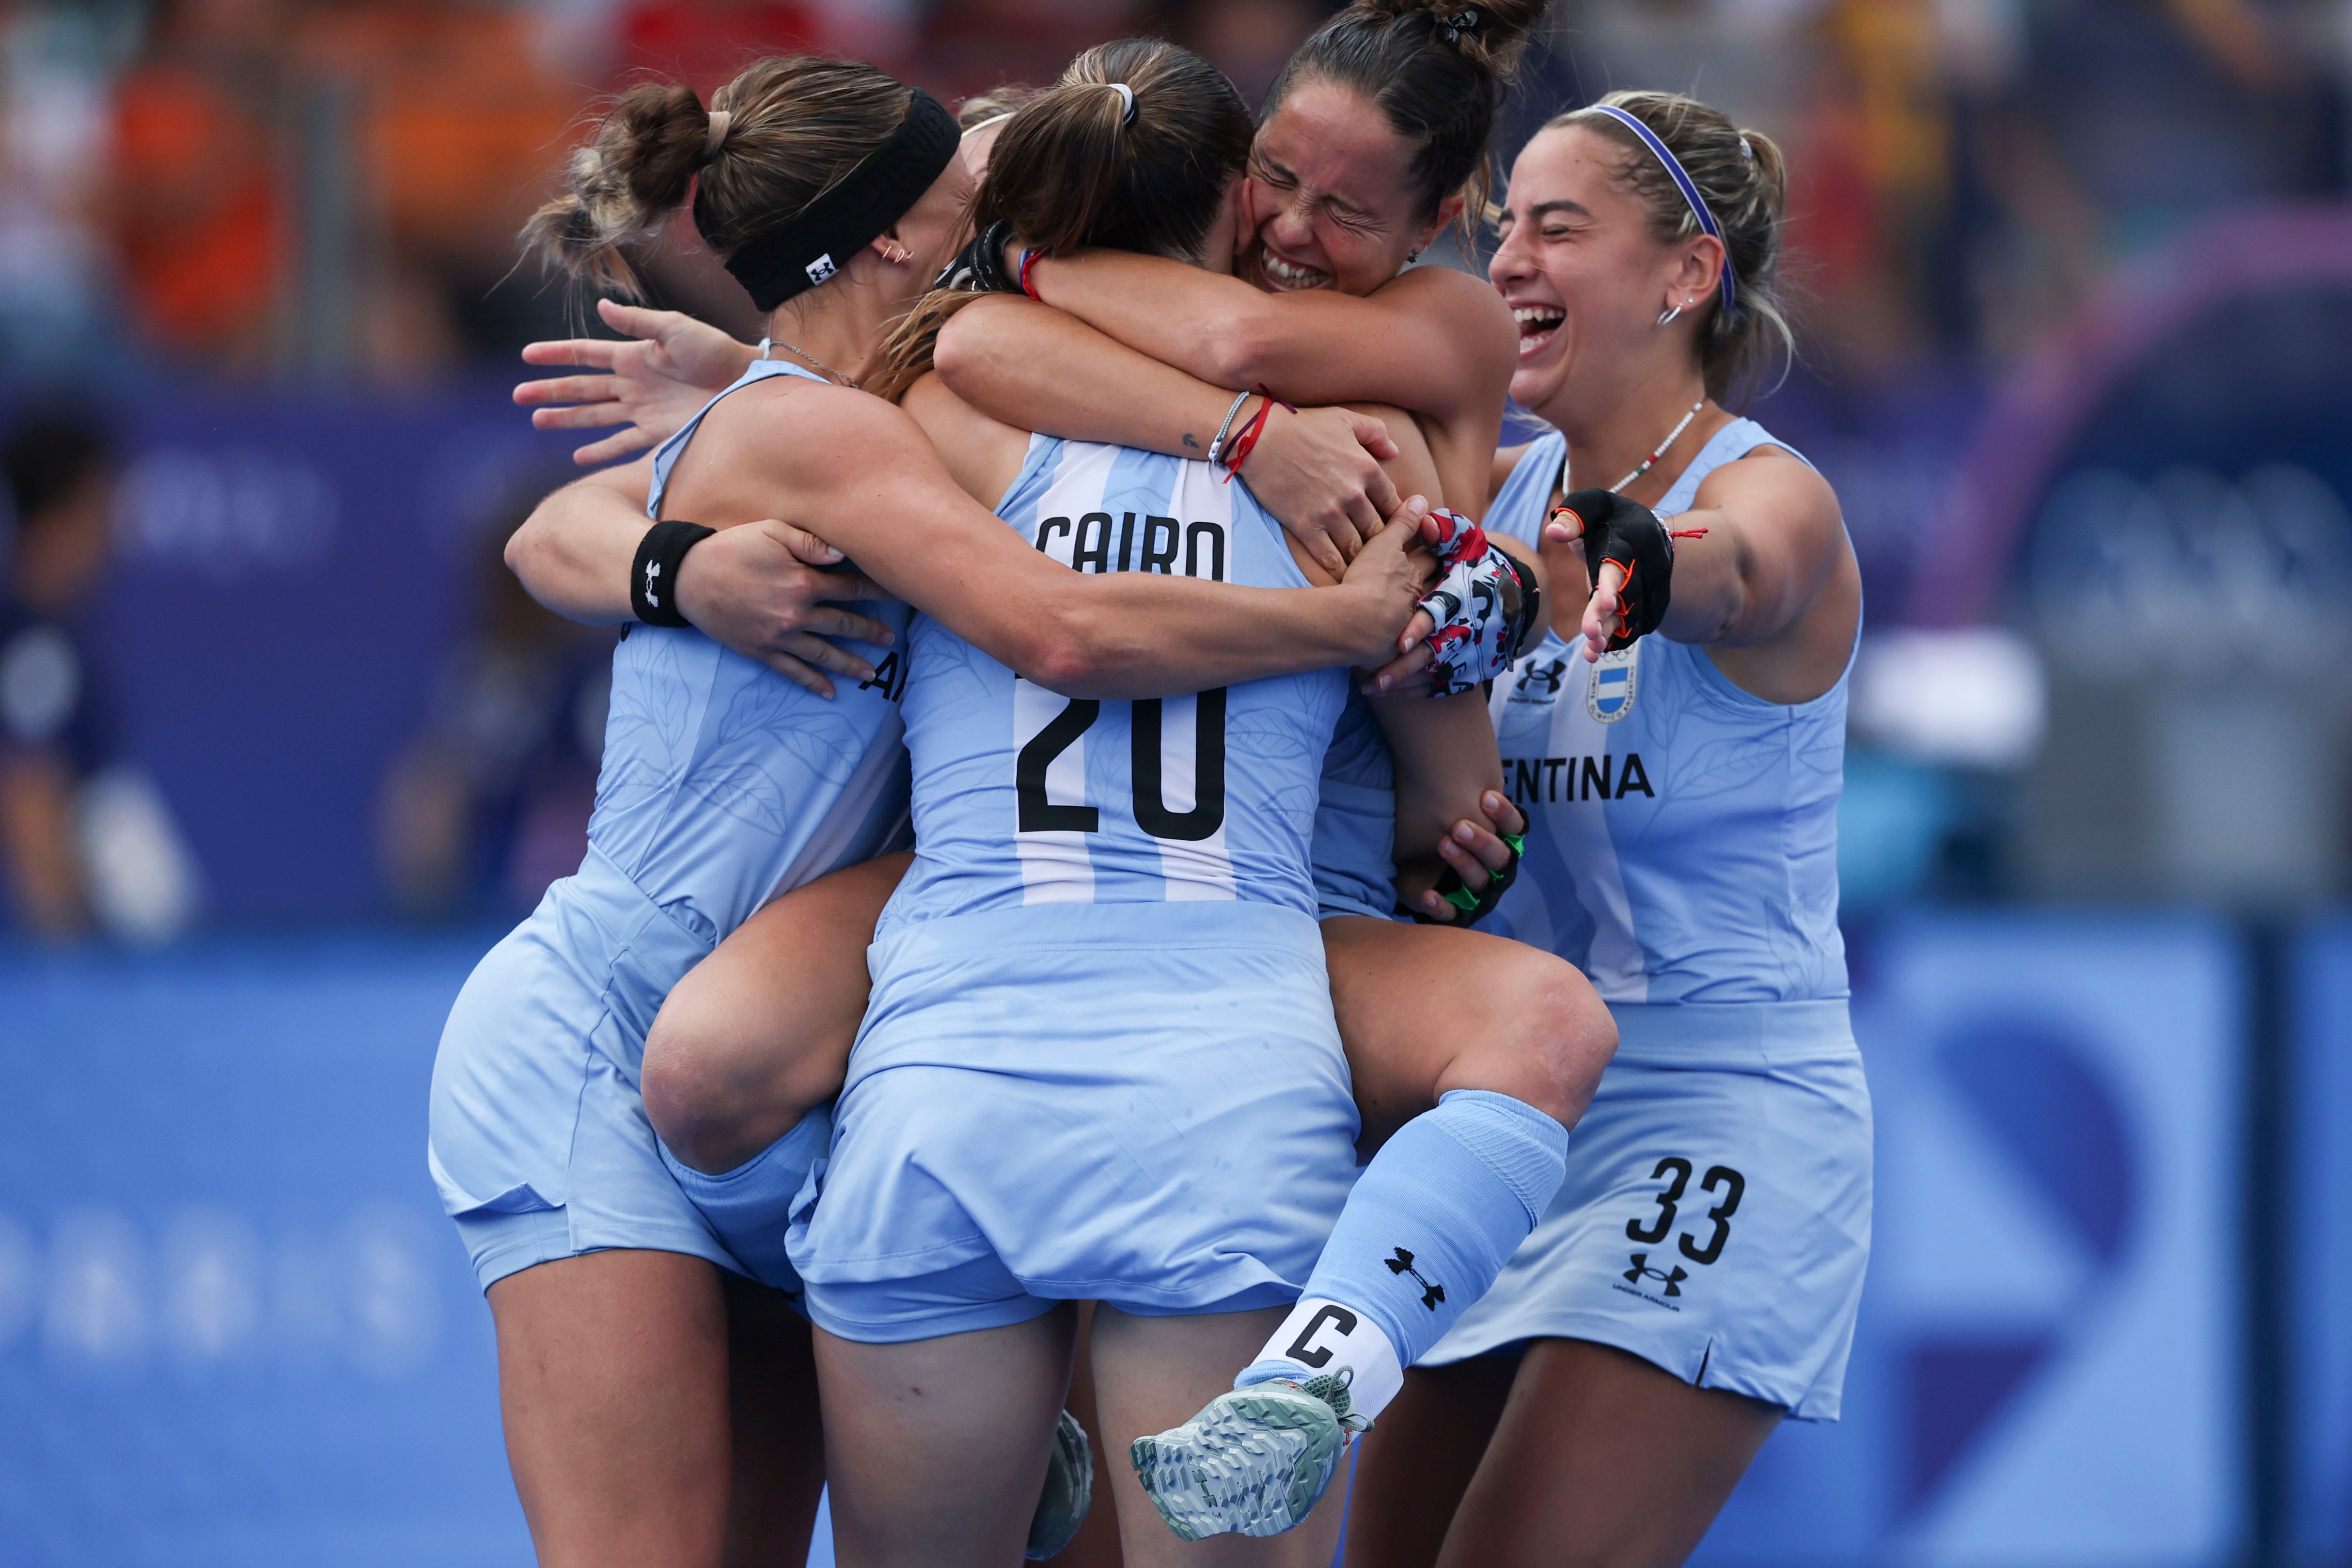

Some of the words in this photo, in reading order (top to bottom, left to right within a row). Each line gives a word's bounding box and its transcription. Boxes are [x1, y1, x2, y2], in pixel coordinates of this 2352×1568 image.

[1035, 512, 1225, 582] CAIRO
[1015, 673, 1227, 841] 20
[1626, 1157, 1745, 1265] 33
[1612, 1283, 1642, 1297] UNDER
[1643, 1294, 1680, 1312] ARMOUR
[1285, 1304, 1358, 1368] C
